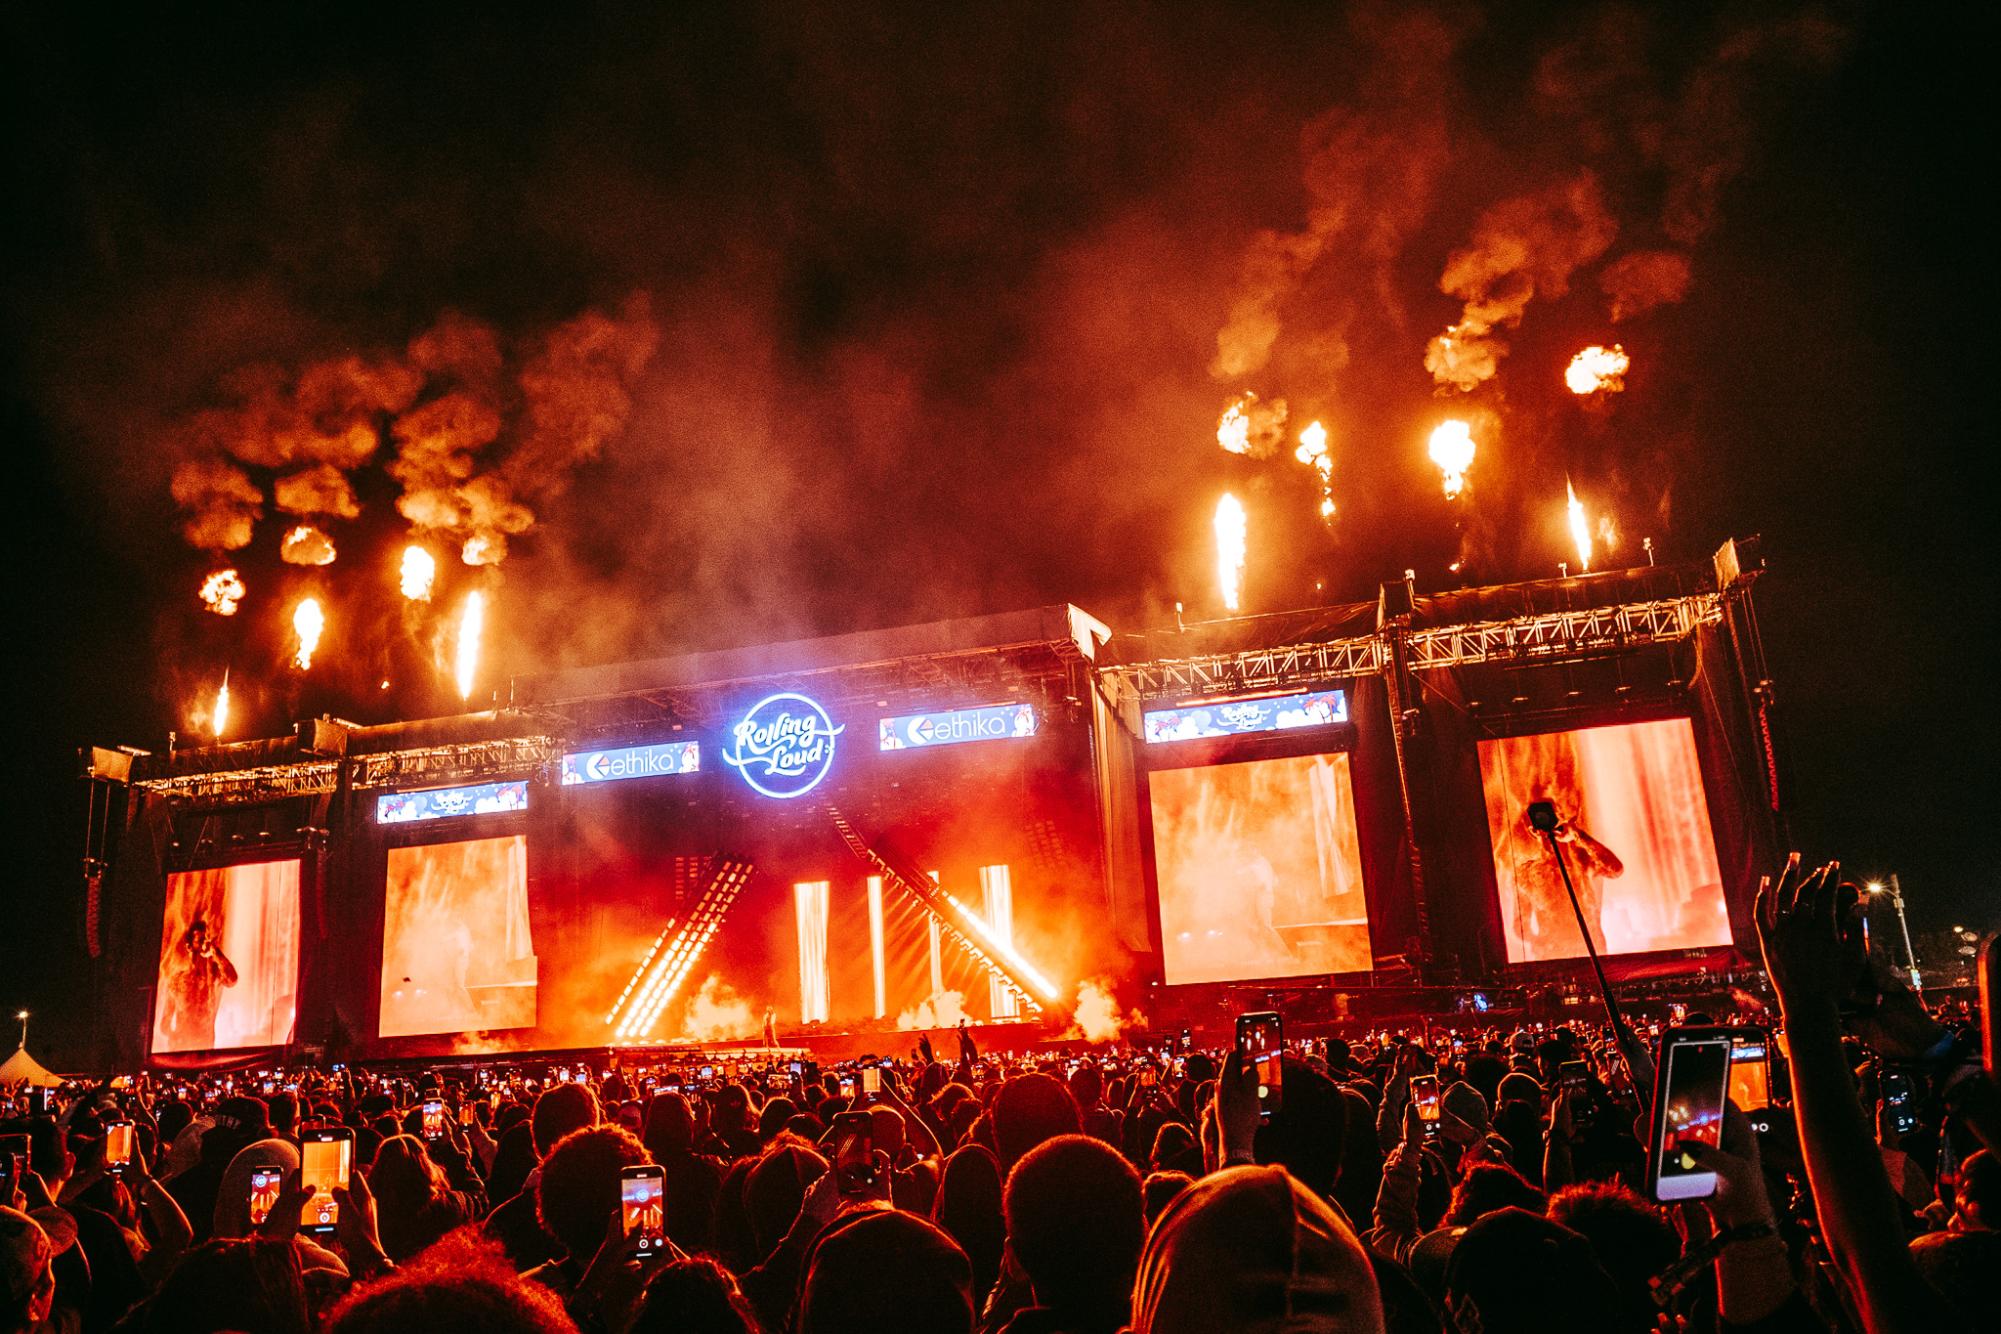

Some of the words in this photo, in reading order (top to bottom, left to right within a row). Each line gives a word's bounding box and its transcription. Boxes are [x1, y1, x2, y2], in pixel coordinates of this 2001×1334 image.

[733, 713, 845, 755] Rolling
[934, 711, 1006, 740] ethika
[610, 748, 674, 776] ethika
[722, 738, 824, 776] Loud
